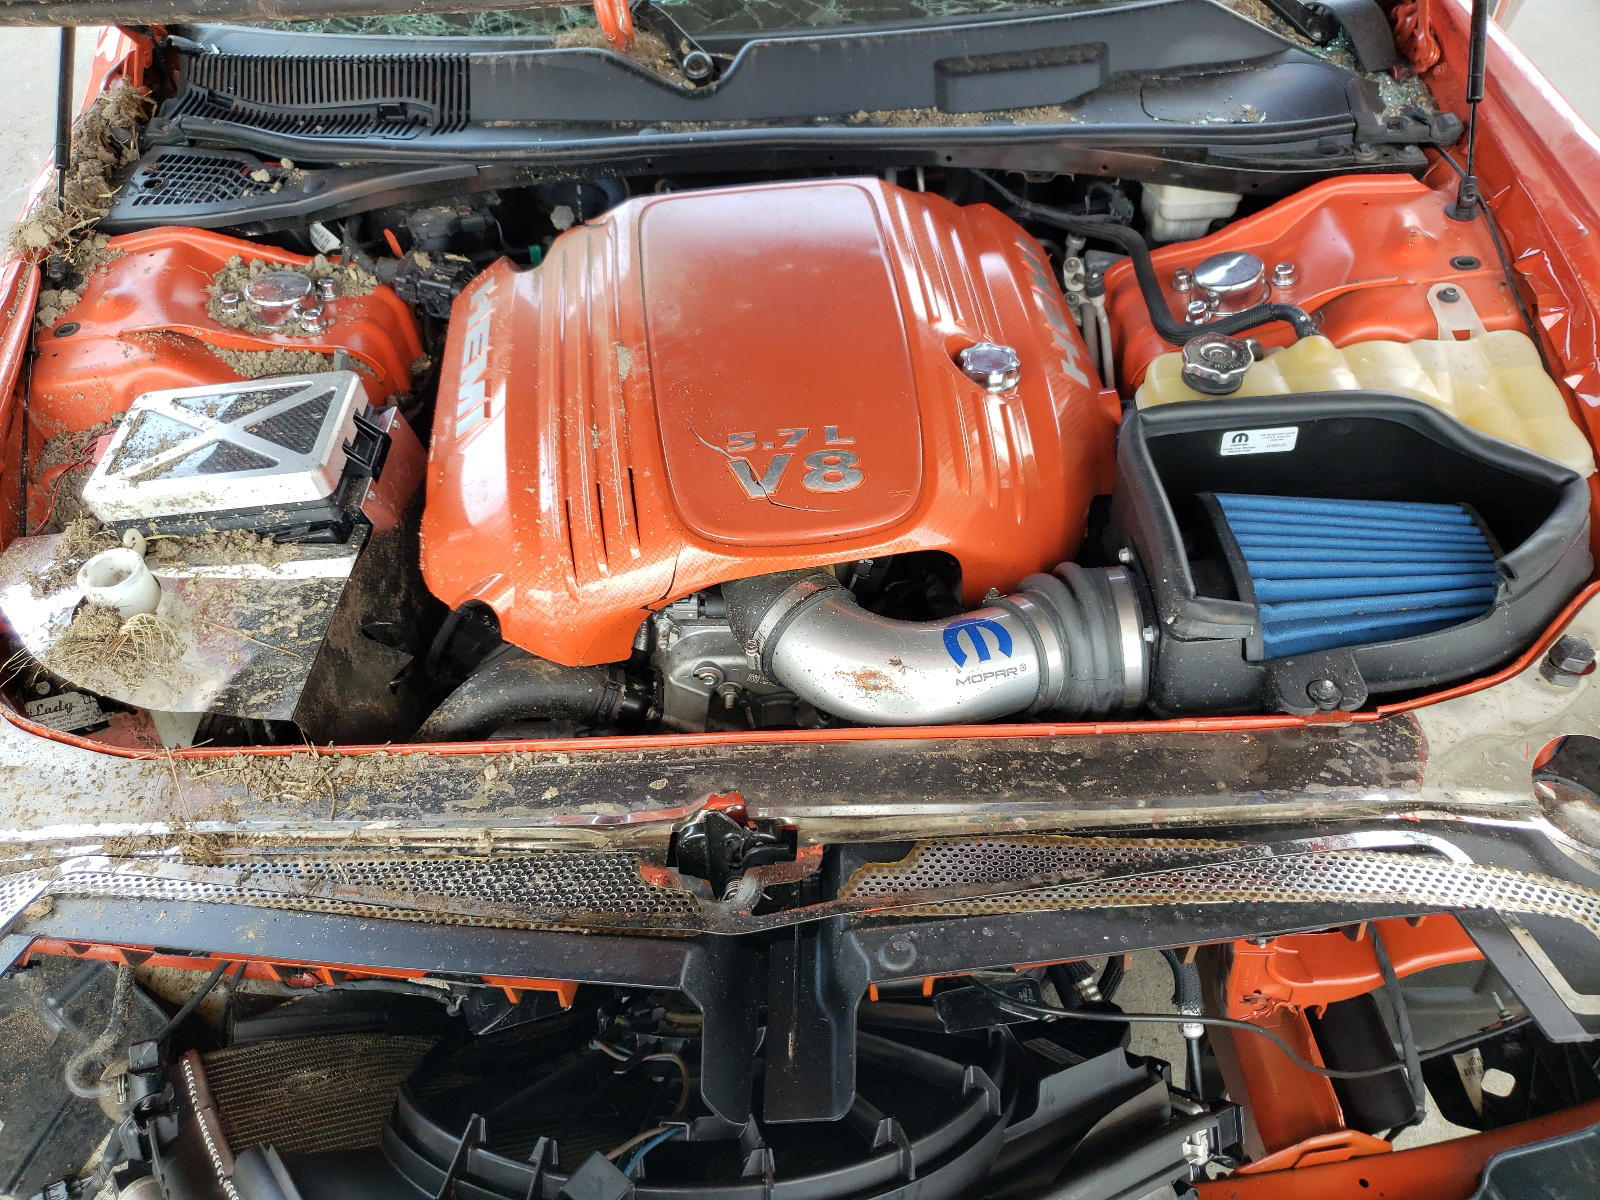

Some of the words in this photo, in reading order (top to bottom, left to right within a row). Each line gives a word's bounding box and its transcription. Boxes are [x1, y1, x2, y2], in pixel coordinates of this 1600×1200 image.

[455, 276, 495, 440] HEMI
[1015, 232, 1091, 390] HEMI
[727, 448, 865, 501] V8
